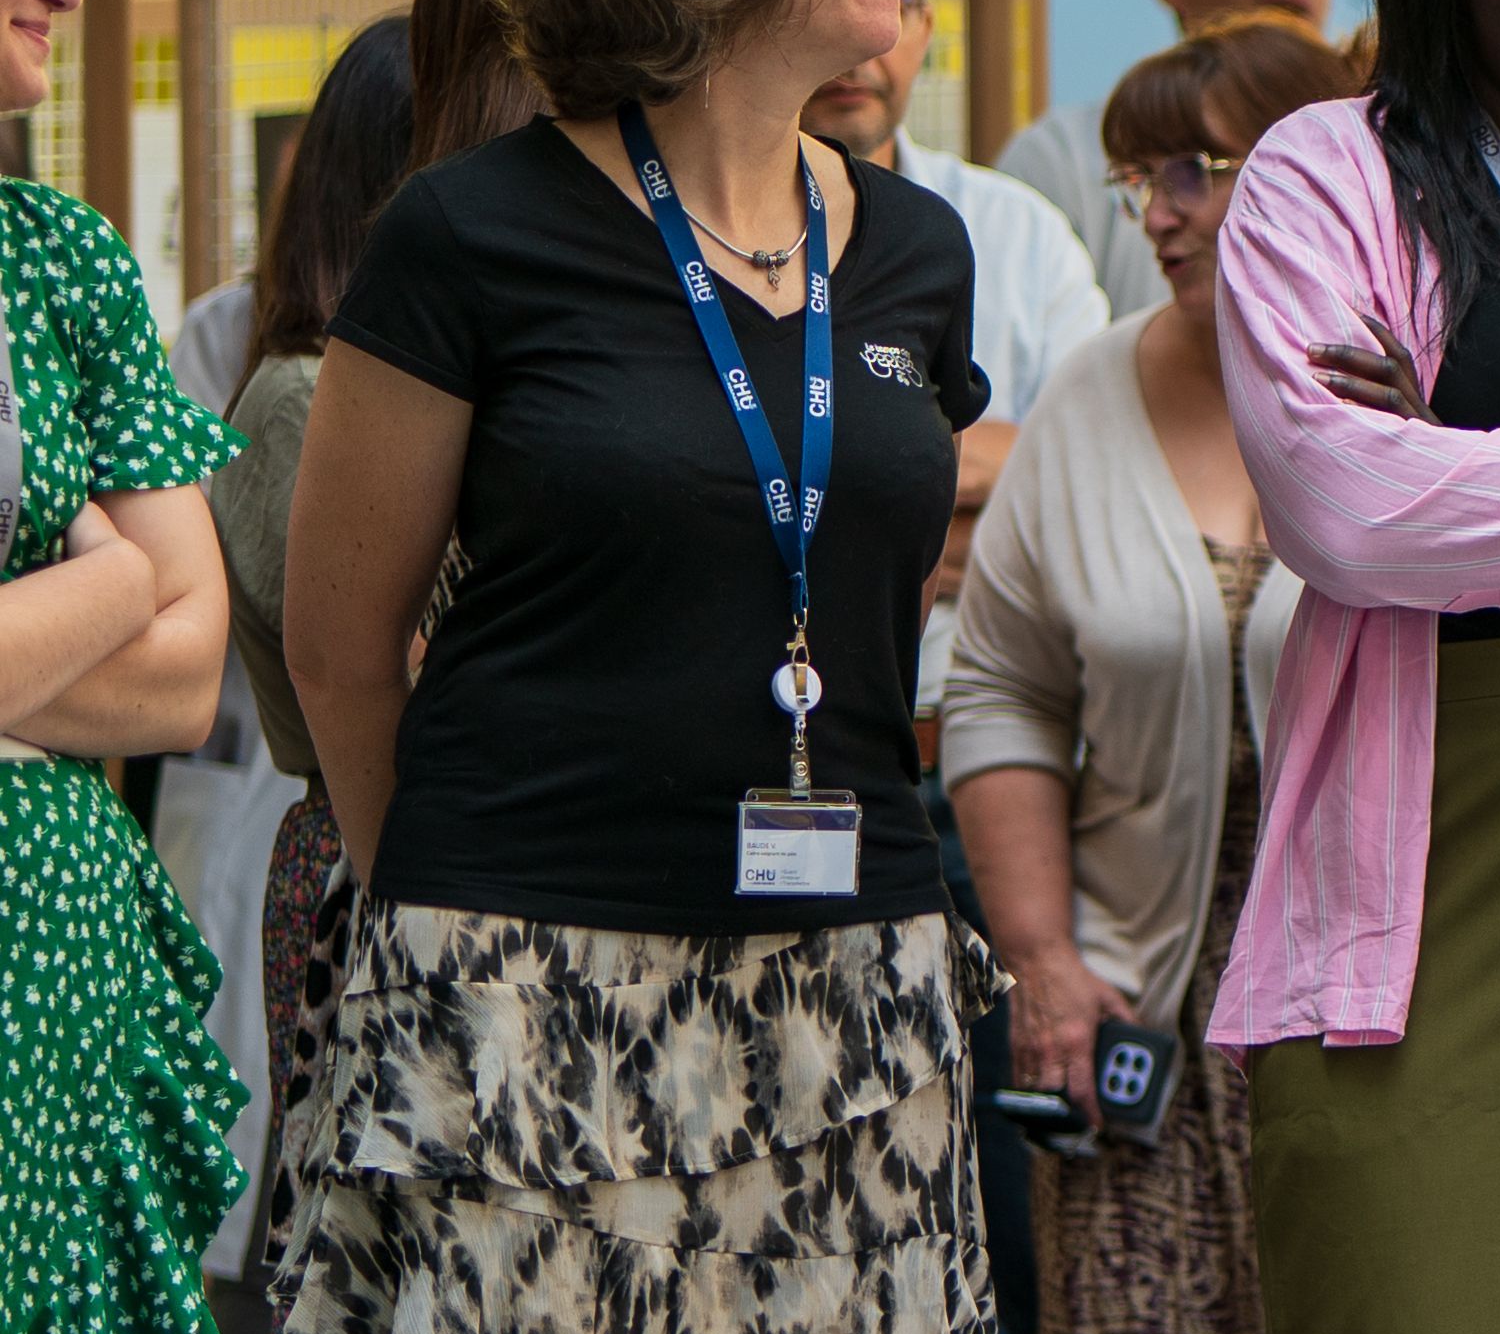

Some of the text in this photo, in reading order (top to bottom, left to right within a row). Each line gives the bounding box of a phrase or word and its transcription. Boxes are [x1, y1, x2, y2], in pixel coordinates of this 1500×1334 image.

[643, 159, 672, 199] CHU
[810, 173, 823, 211] CHU
[685, 261, 714, 302] CHU
[811, 273, 829, 314] CHU
[728, 368, 757, 410] CHU
[810, 376, 827, 417] CHU
[769, 478, 794, 524] CHU
[803, 487, 823, 532] CHU
[745, 869, 776, 881] CHU
